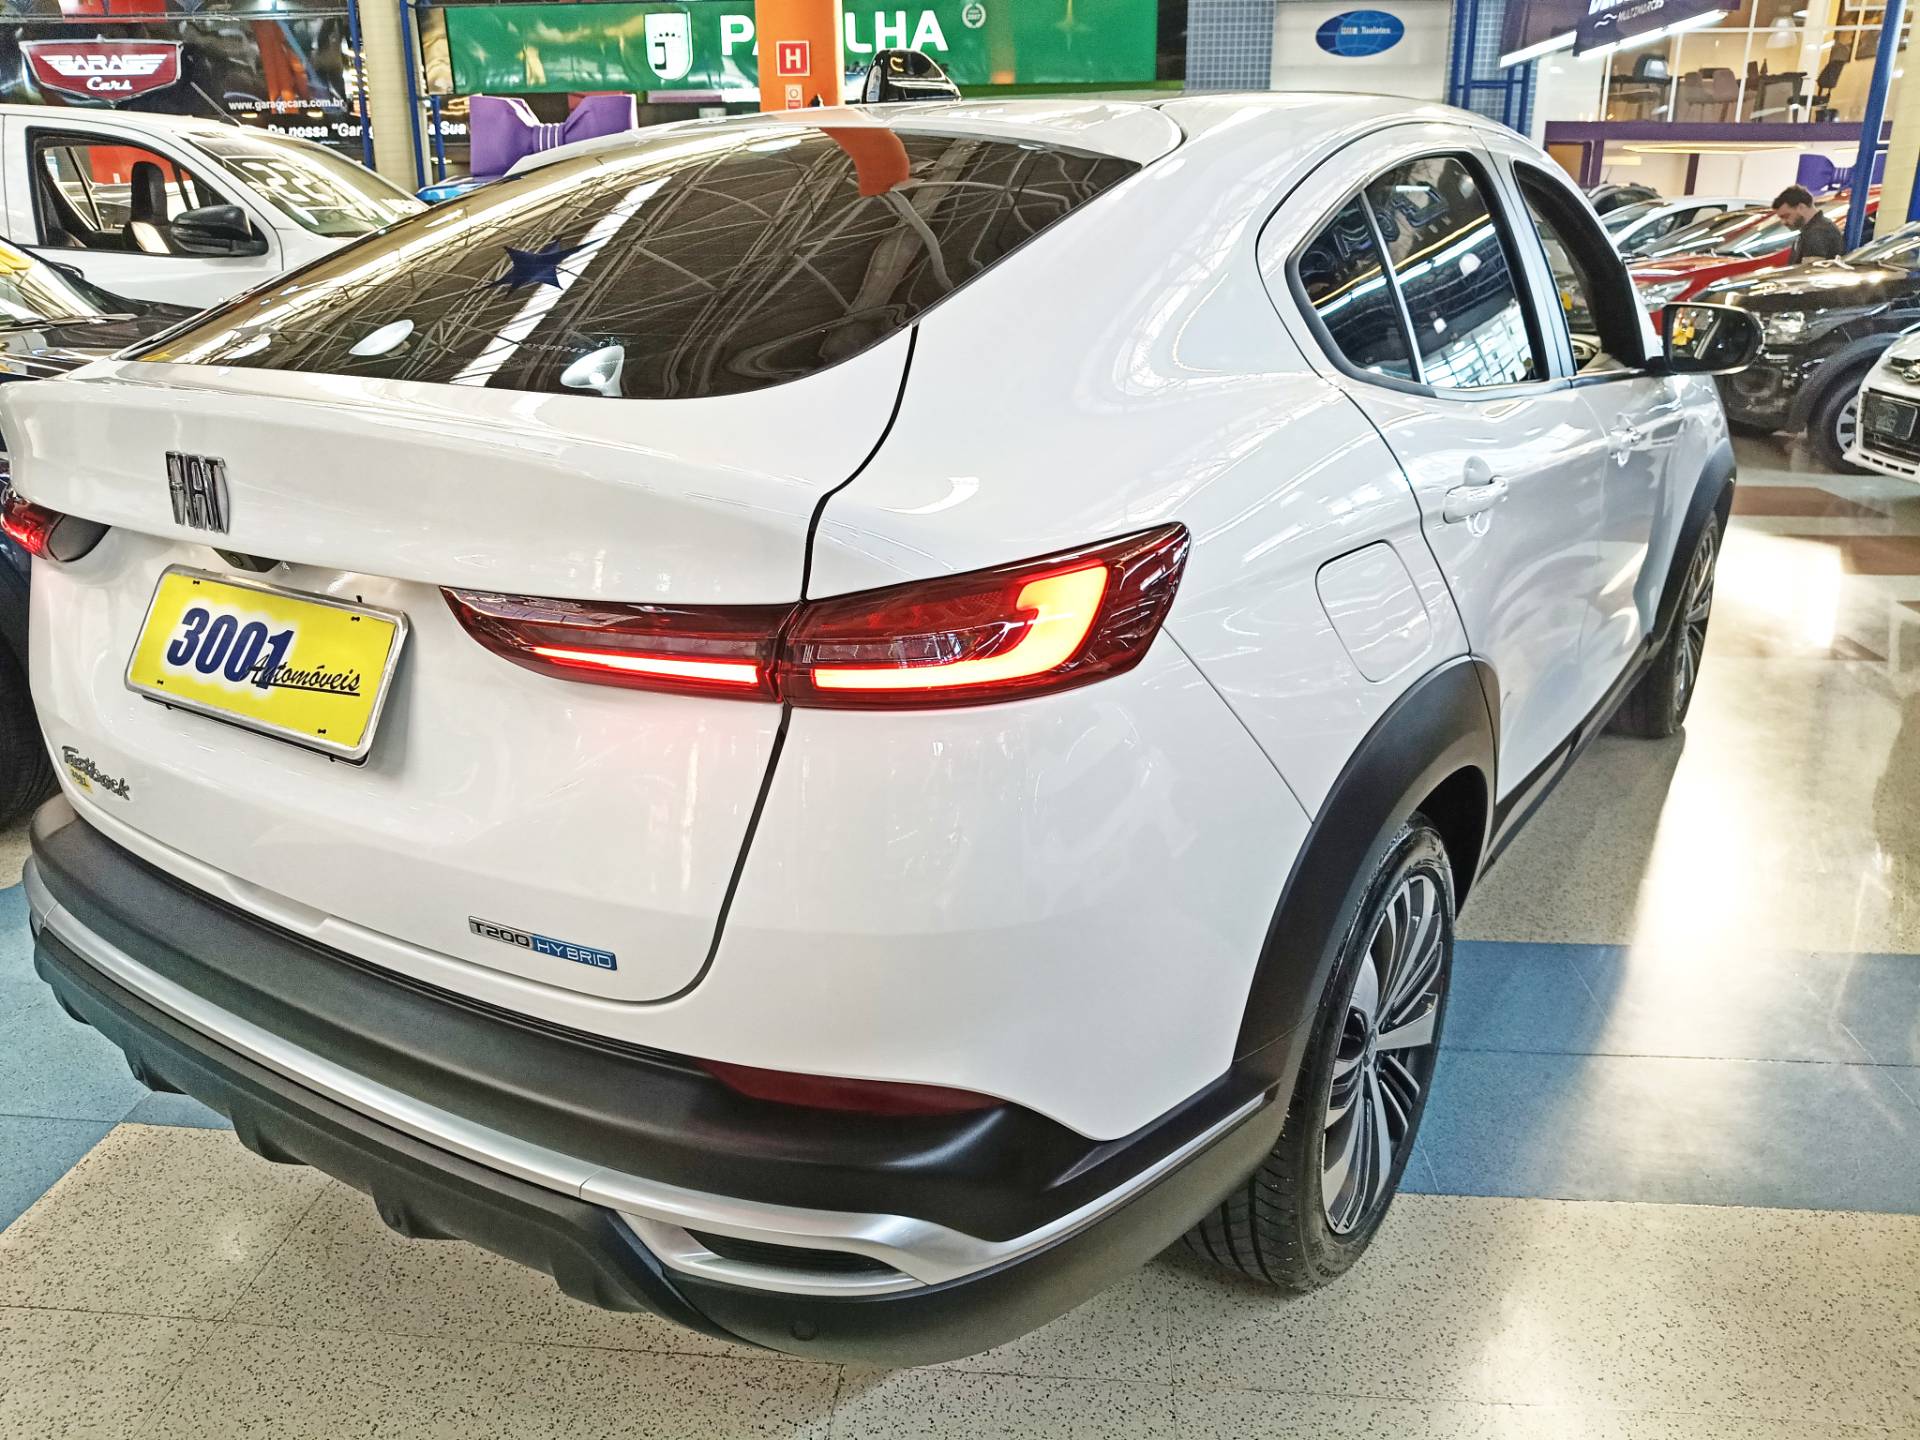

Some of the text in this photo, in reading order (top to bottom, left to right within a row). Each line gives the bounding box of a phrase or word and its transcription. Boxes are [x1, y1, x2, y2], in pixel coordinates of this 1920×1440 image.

[785, 48, 801, 69] H
[86, 77, 133, 91] Cars
[229, 98, 344, 111] www.garagecars.com.br
[288, 124, 328, 137] nossa
[441, 121, 467, 135] Sua
[165, 451, 229, 534] FIAT
[167, 607, 360, 692] 3001 Automóveis
[62, 745, 130, 800] Fastback
[471, 921, 612, 968] T200 HYBRID
